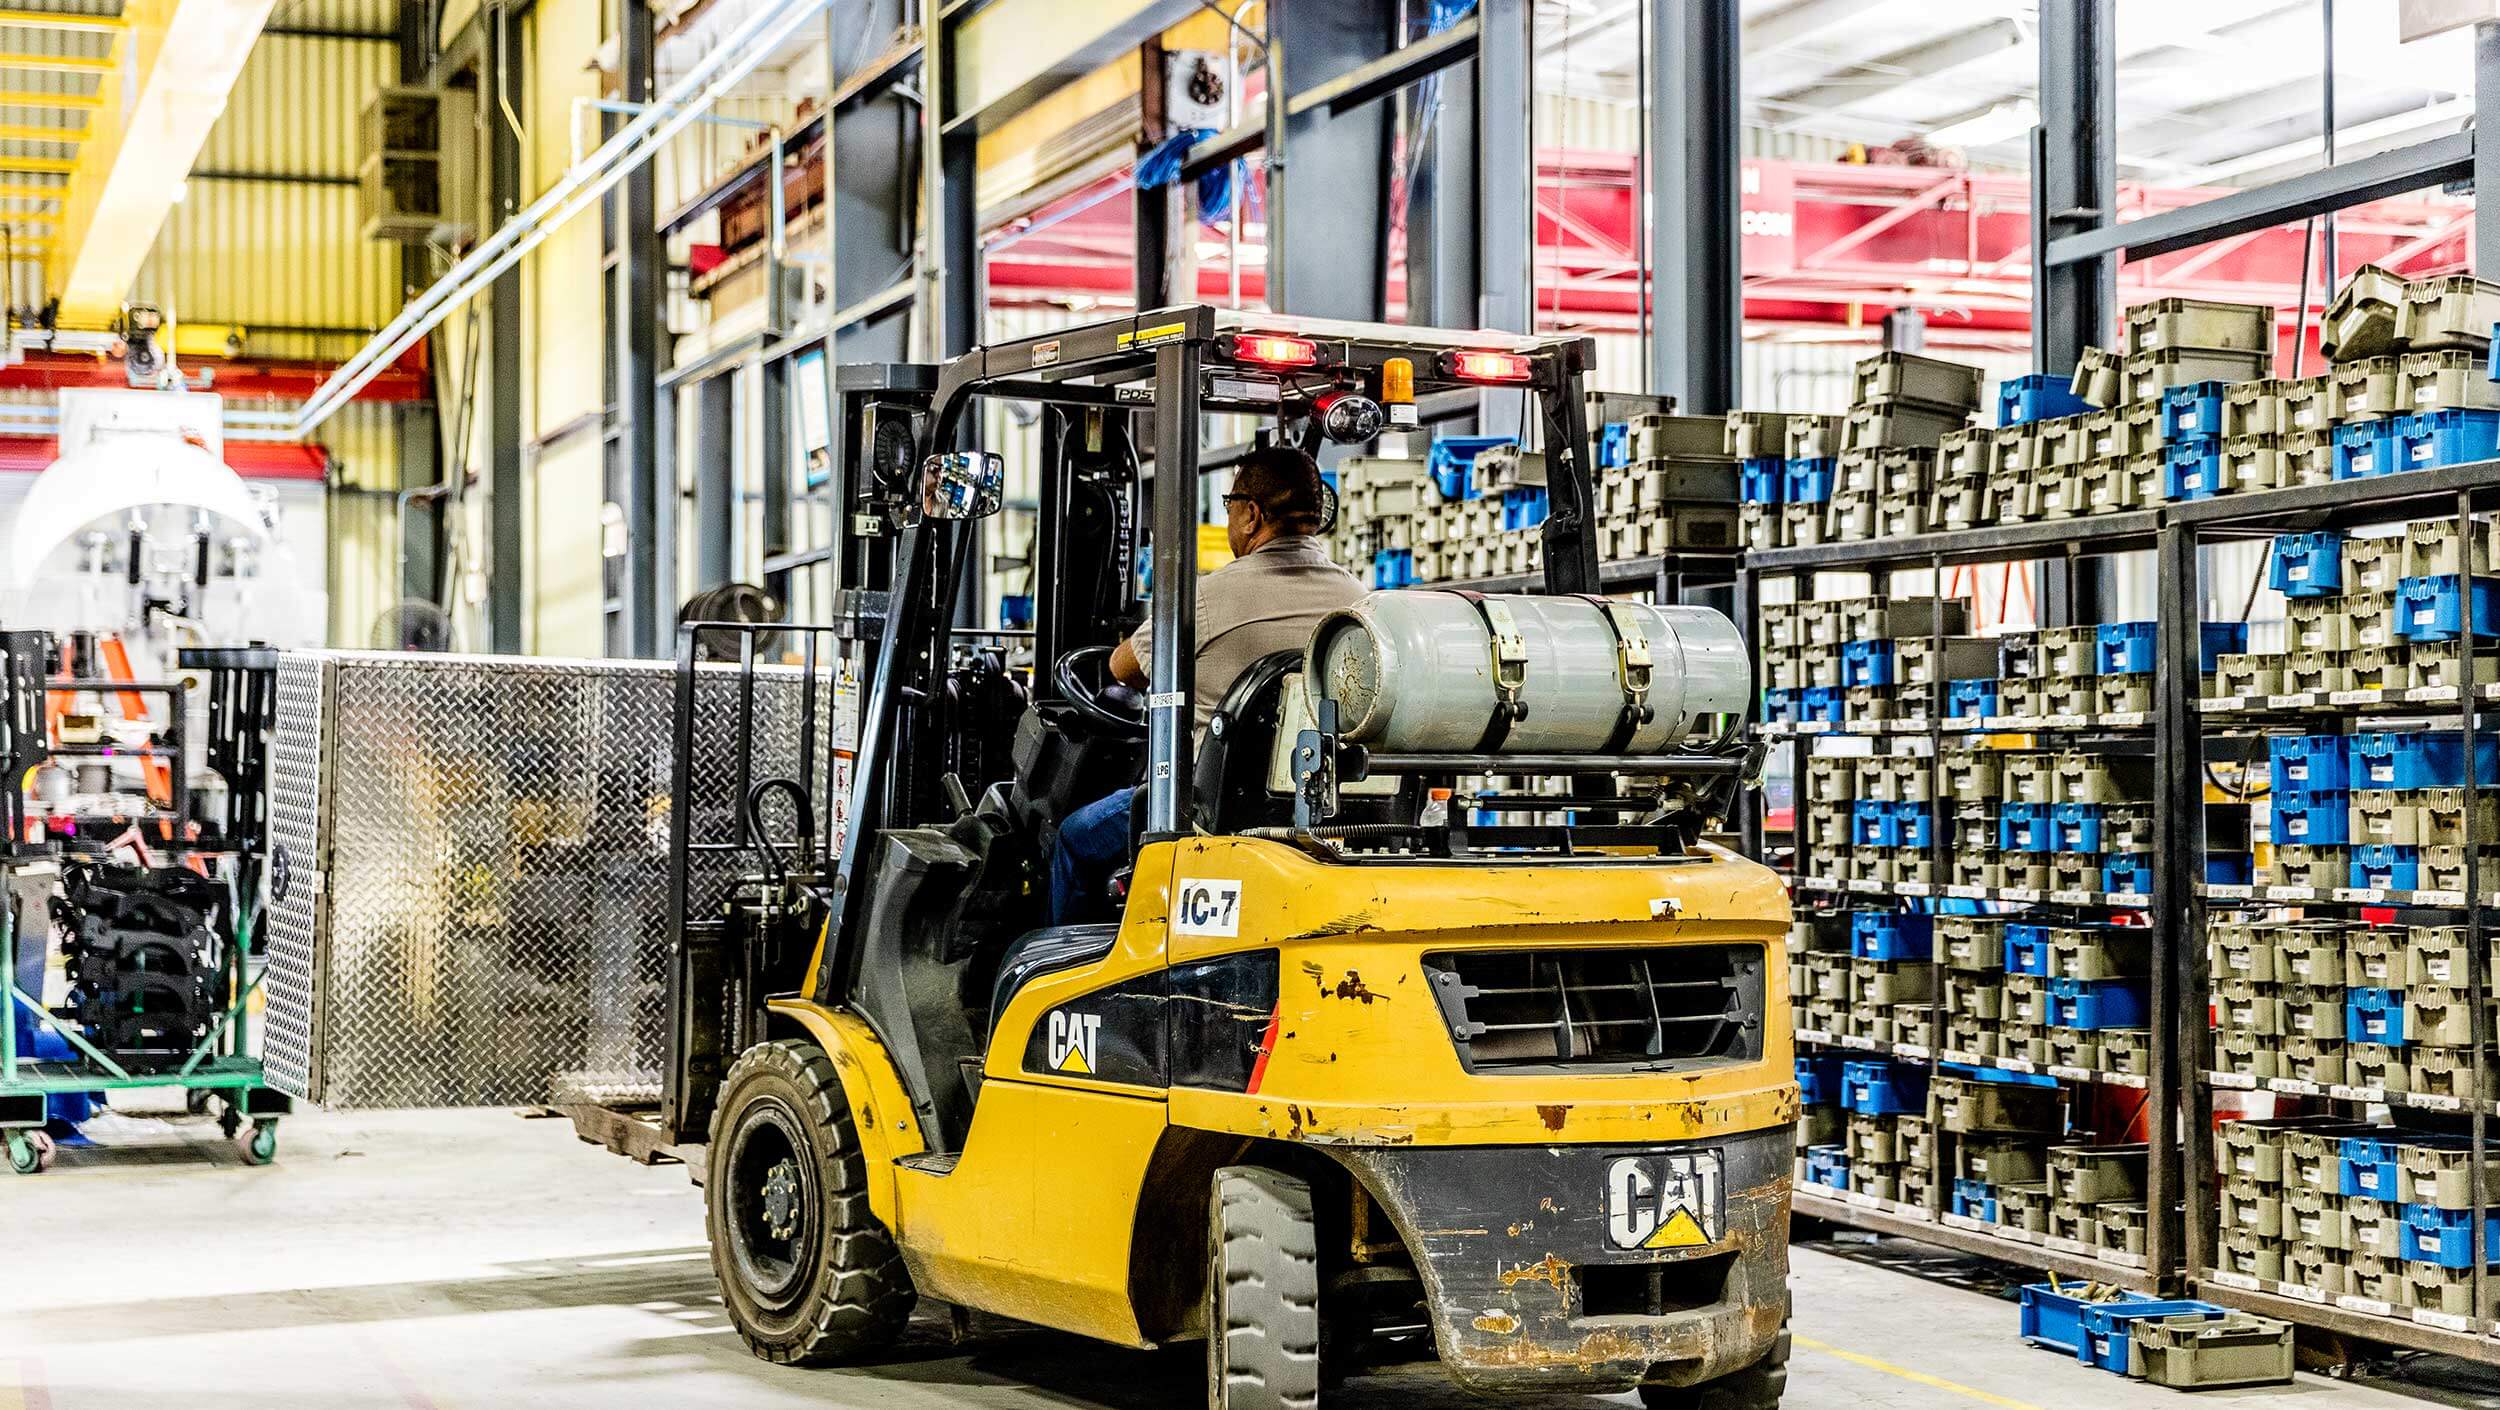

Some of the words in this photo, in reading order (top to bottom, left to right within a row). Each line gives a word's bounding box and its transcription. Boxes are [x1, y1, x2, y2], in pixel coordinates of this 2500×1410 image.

[1156, 764, 1169, 777] LPG
[1181, 888, 1236, 926] IC-7
[1661, 900, 1671, 916] 7
[1048, 1010, 1101, 1074] CAT
[1608, 1154, 1718, 1249] CAT
